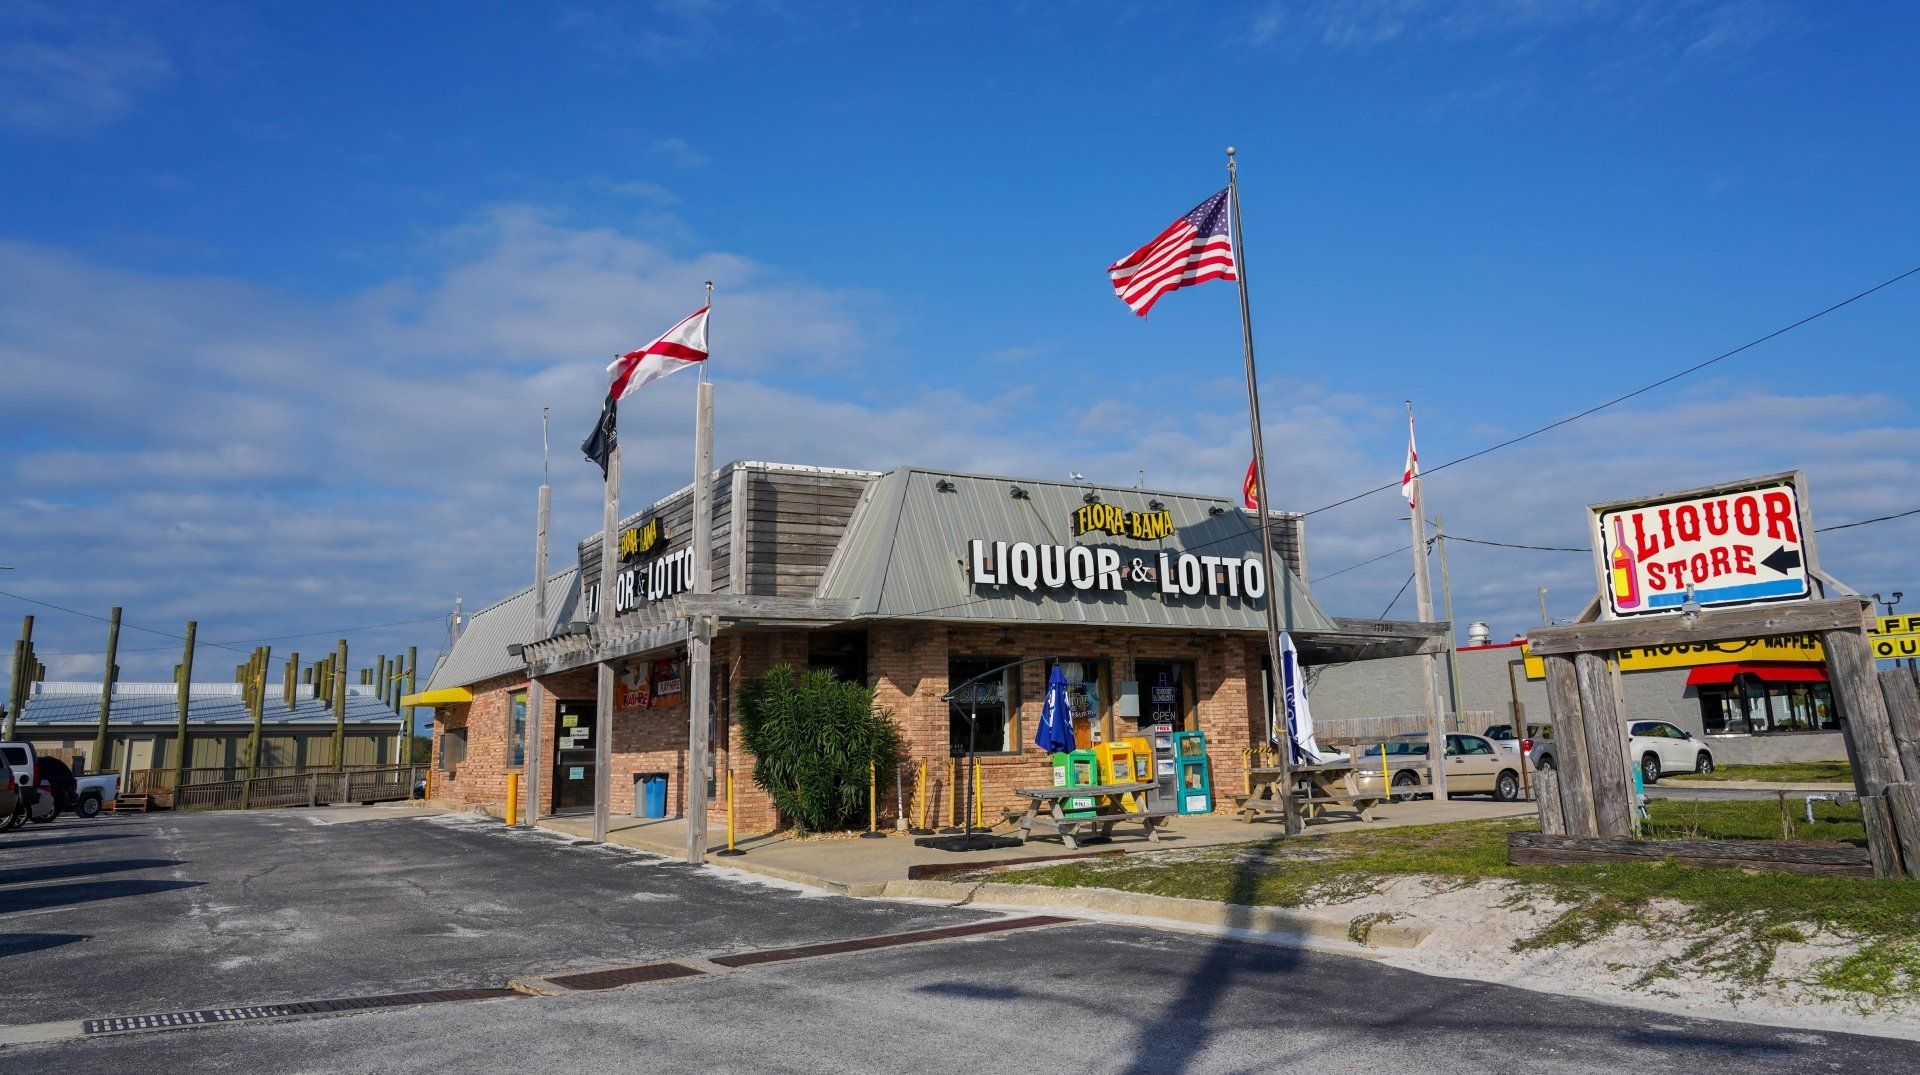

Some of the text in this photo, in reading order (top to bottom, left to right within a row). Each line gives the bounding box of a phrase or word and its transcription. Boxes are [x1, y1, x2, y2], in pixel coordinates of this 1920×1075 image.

[1077, 502, 1175, 540] FLORA-BAMA
[1632, 491, 1798, 564] LIQUOR
[588, 570, 635, 619] LIOR
[647, 545, 696, 601] LOTTO
[972, 539, 1266, 599] LIQUOR & LOTTO
[1647, 544, 1757, 591] STORE
[1152, 711, 1176, 721] OPEN
